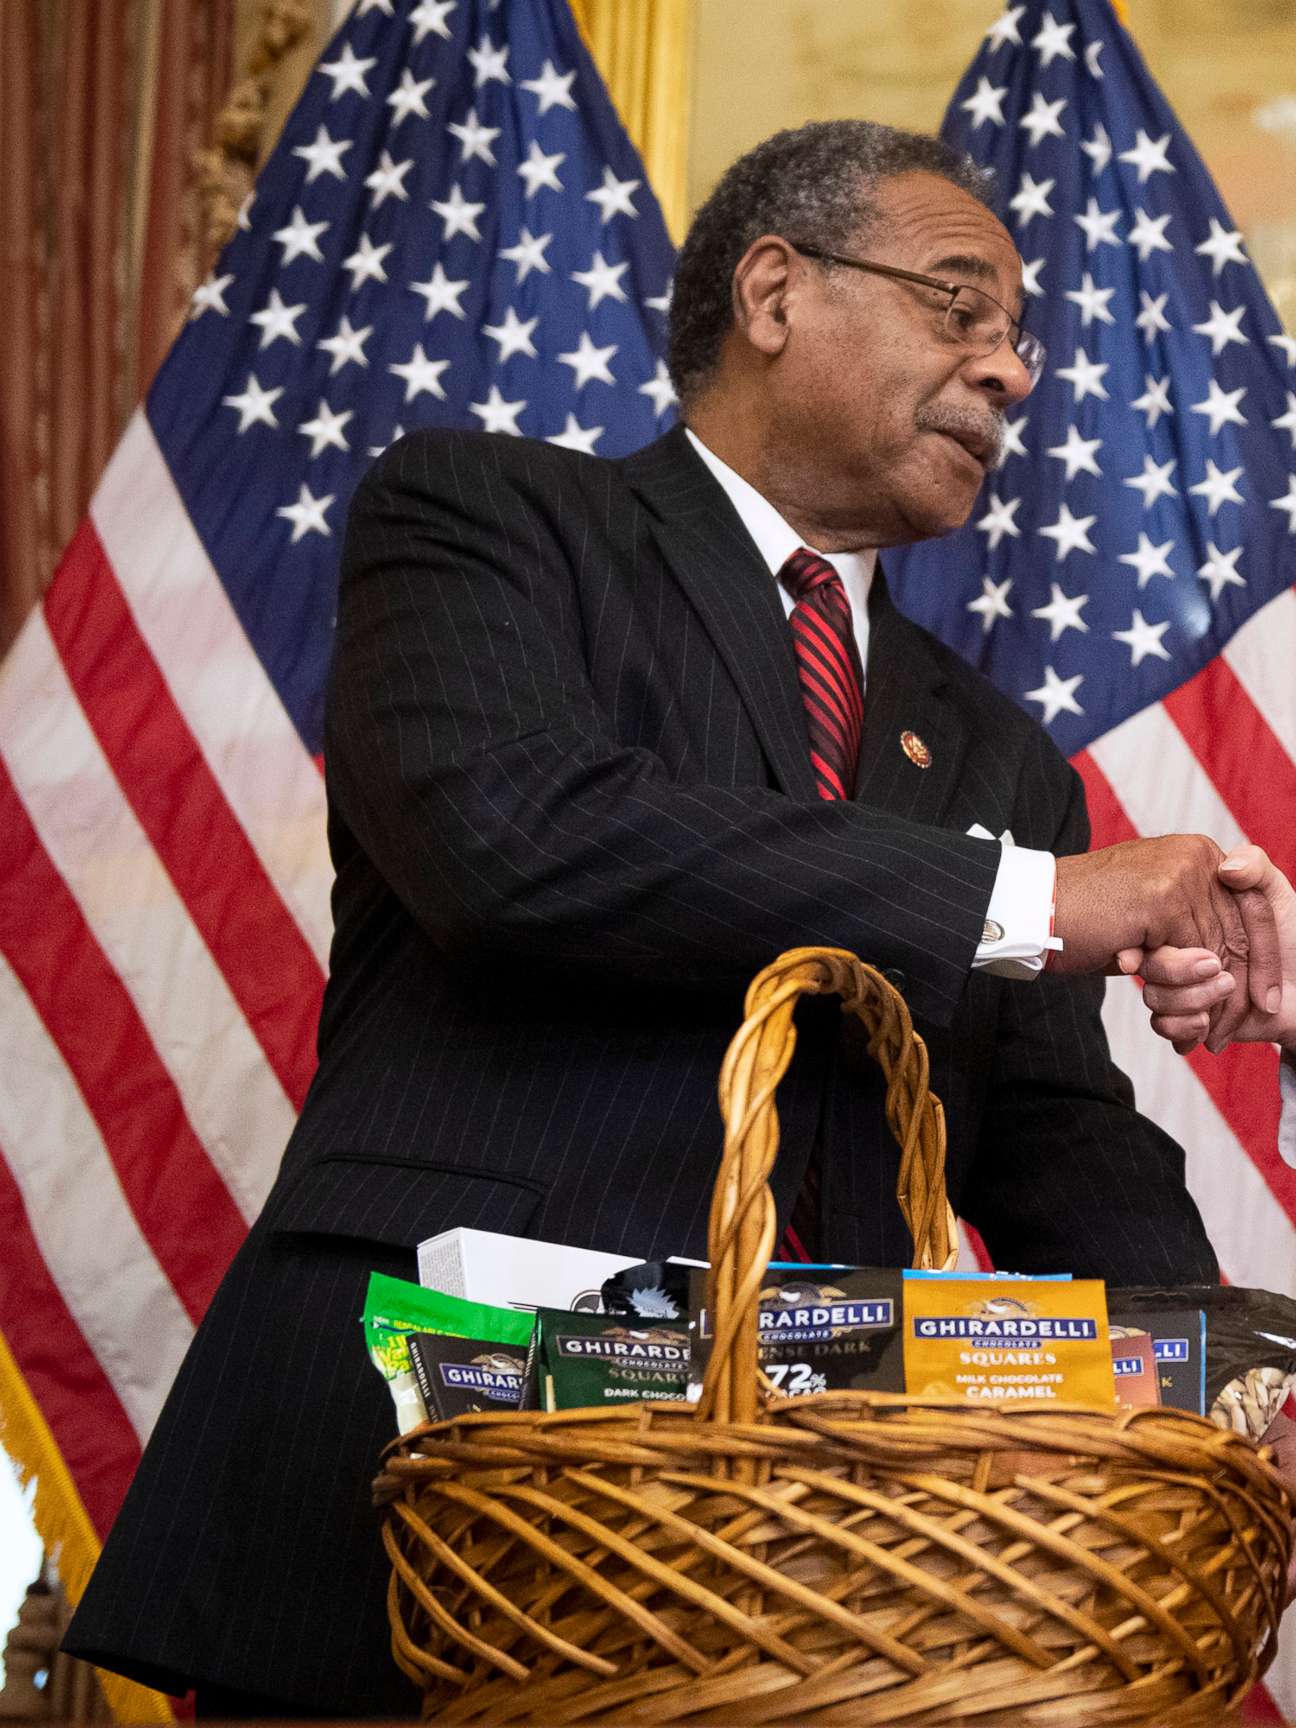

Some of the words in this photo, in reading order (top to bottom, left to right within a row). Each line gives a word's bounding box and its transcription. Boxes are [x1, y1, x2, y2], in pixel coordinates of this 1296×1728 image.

[759, 1305, 884, 1329] RARDELLI
[763, 1330, 829, 1341] CHOCOLATE
[919, 1320, 1090, 1337] GHIRARDELLI
[813, 1340, 872, 1357] DARK
[974, 1340, 1039, 1348] CHOCOLATE
[621, 1357, 685, 1370] CHOCOLATE
[959, 1351, 1057, 1367] SQUARES
[410, 1341, 432, 1398] GHIRARDELLI
[765, 1363, 828, 1390] 72%
[448, 1367, 523, 1391] GHIRAR
[956, 1374, 986, 1384] MILK
[989, 1373, 1064, 1384] CHOCOLATE
[603, 1387, 640, 1399] DARK
[965, 1386, 1057, 1399] CARAMEL
